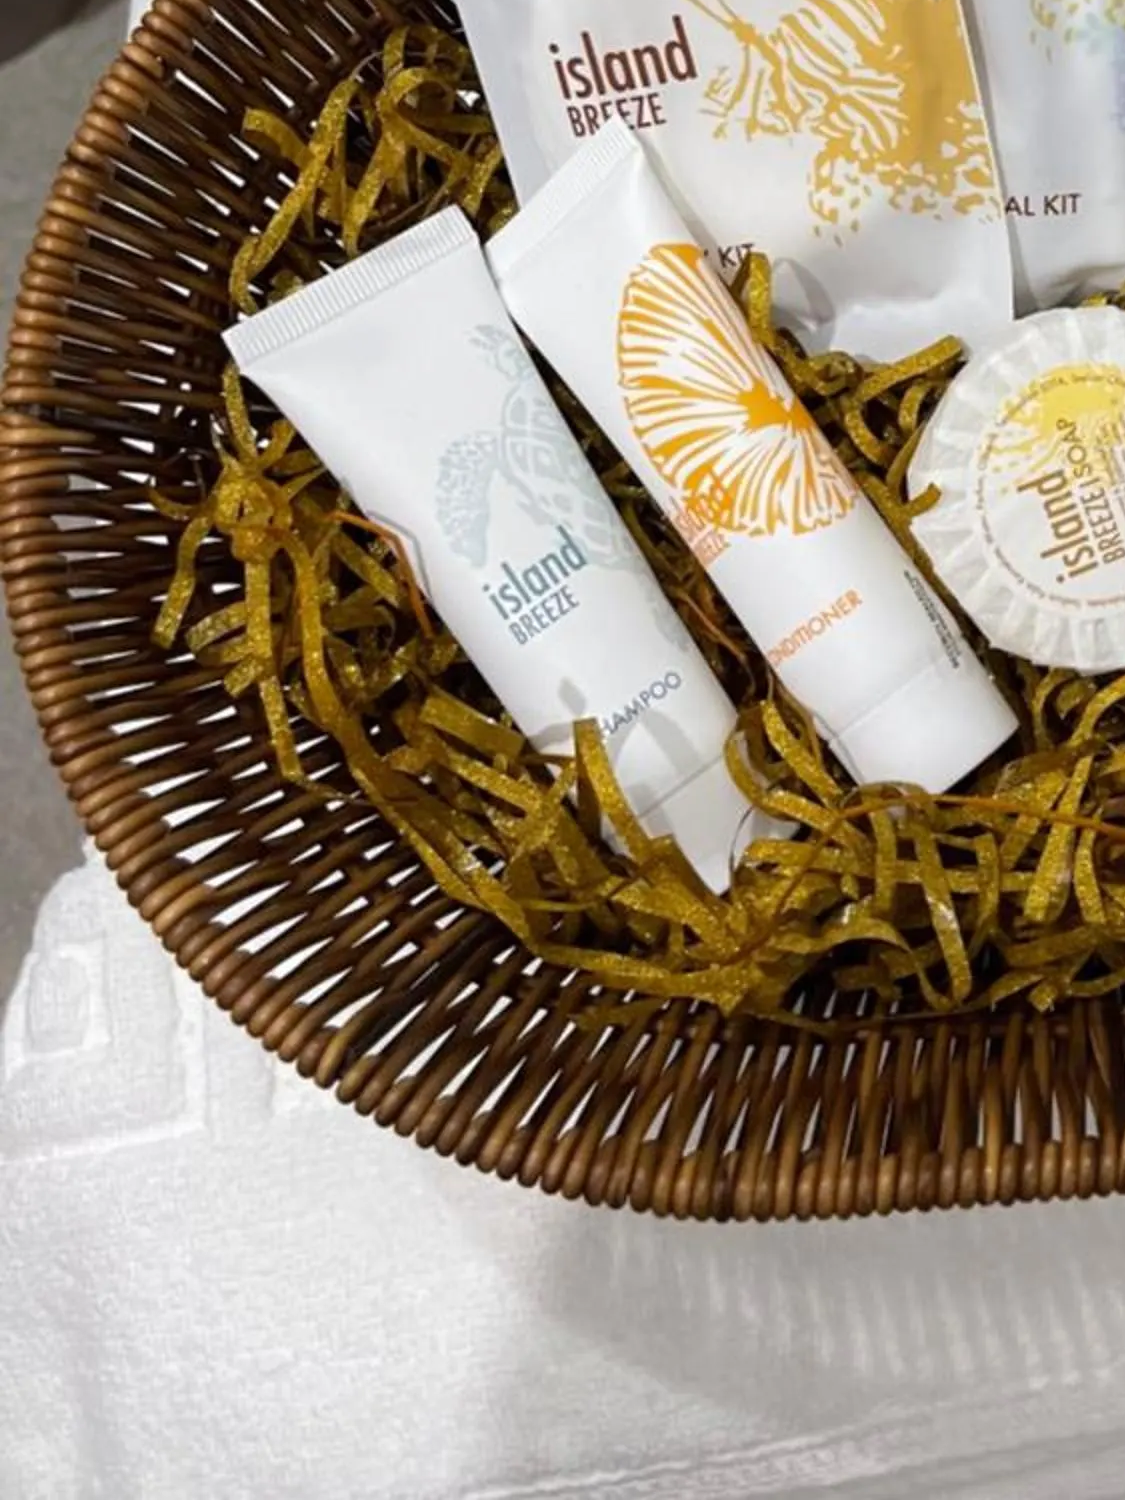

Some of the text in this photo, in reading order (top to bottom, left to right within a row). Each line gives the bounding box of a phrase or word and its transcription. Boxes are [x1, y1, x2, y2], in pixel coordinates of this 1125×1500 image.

[549, 13, 698, 100] island
[1043, 192, 1082, 216] KIT
[1056, 417, 1092, 478] SOAP
[1016, 469, 1099, 584] island
[482, 524, 588, 621] island
[509, 584, 580, 646] BREEZE
